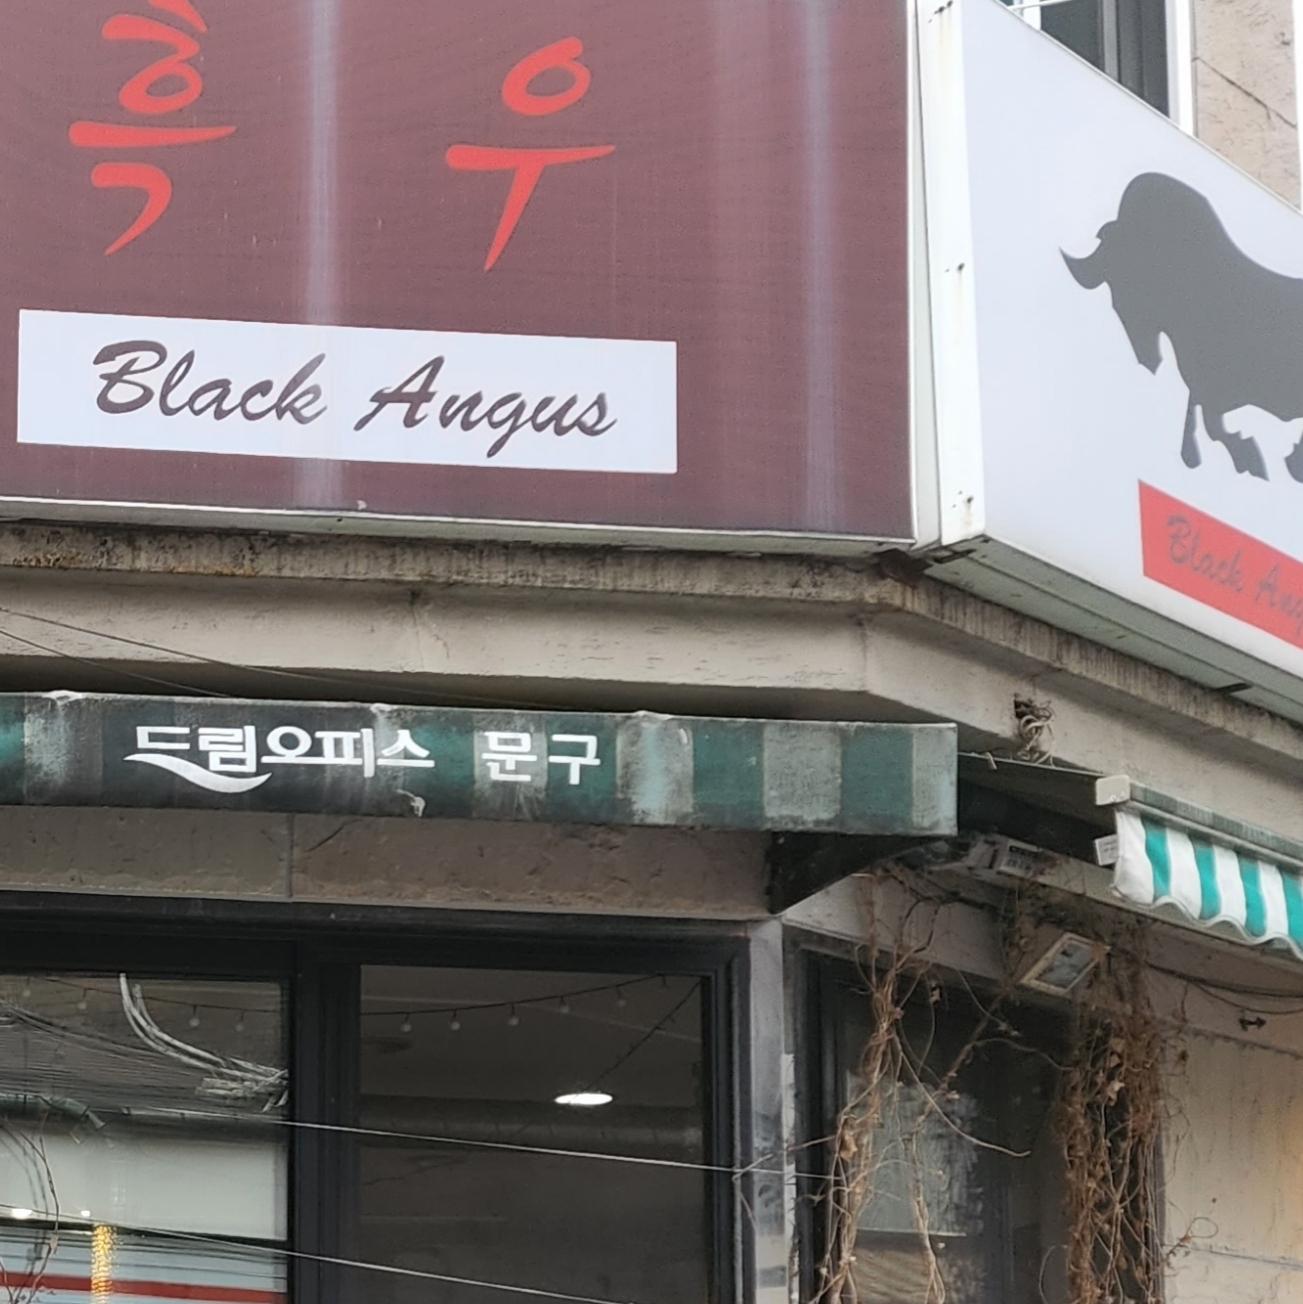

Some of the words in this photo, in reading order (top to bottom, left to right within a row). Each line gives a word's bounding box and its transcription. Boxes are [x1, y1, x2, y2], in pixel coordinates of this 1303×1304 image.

[92, 340, 328, 426] Black
[353, 355, 617, 459] Angus
[1166, 514, 1243, 593] Black
[124, 725, 436, 794] 드림오피스
[480, 731, 602, 786] 문구
